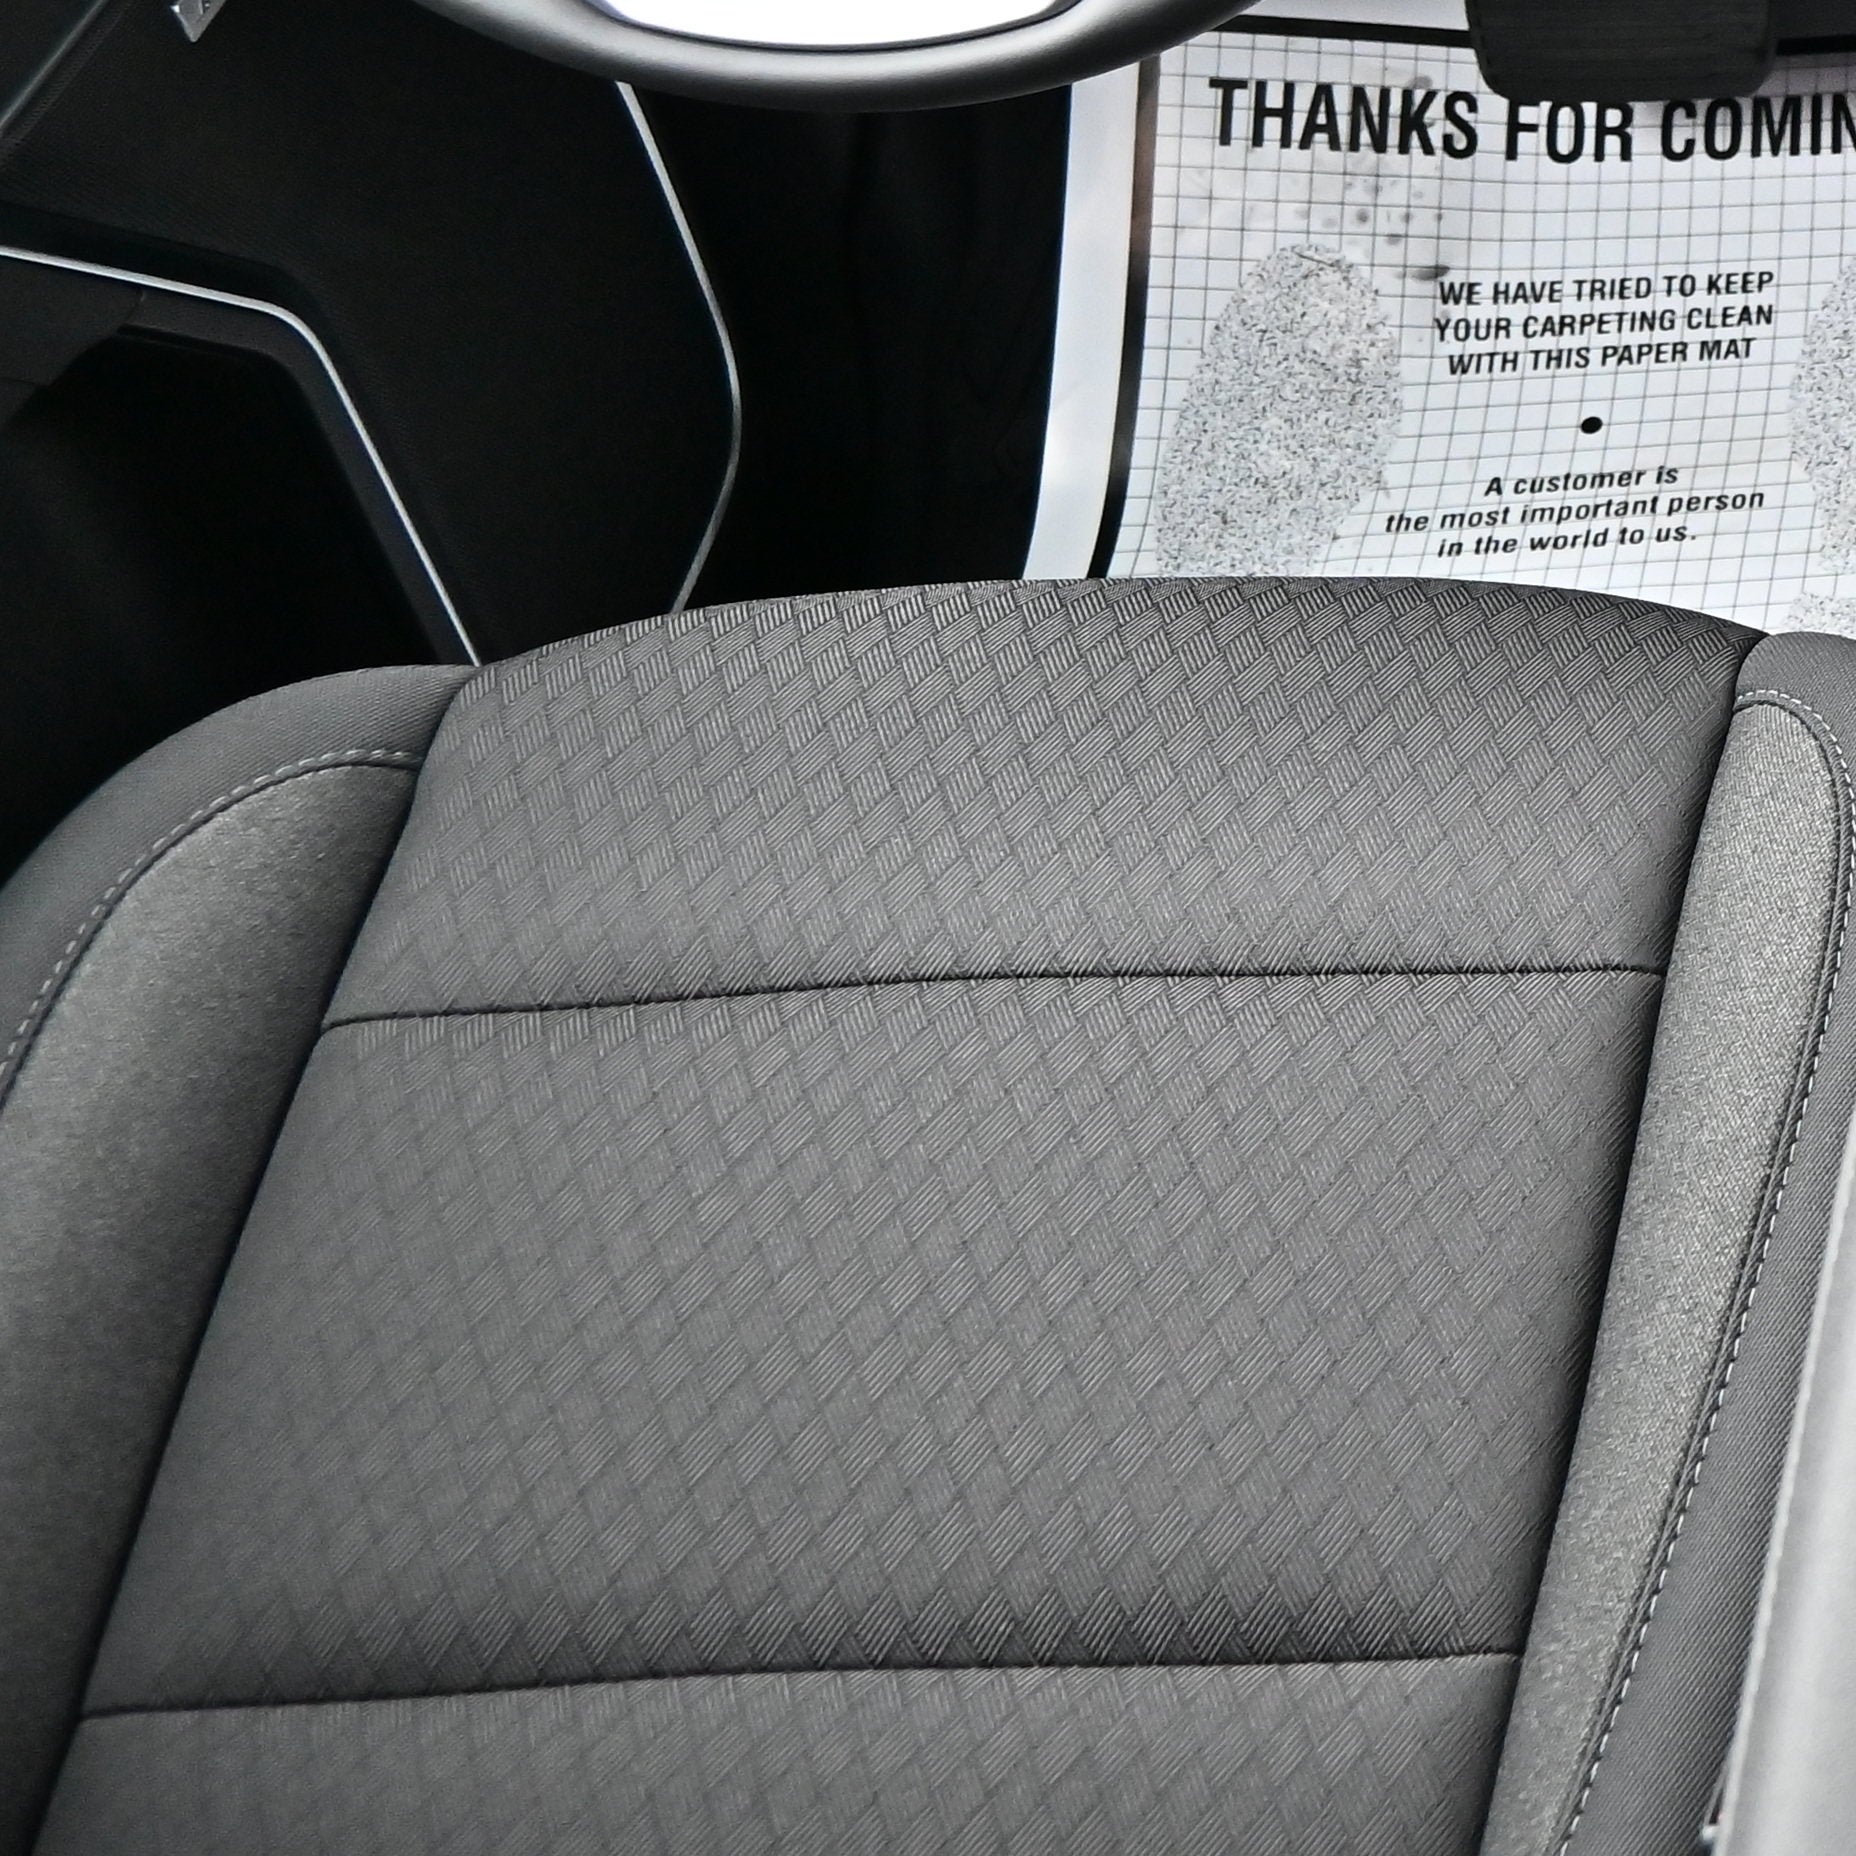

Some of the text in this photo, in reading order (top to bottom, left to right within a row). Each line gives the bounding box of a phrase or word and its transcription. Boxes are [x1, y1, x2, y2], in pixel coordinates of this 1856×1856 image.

[1208, 75, 1479, 161] THANKS
[1506, 100, 1634, 163] FOR
[1438, 270, 1775, 307] WE HAVE TRIED TO KEEP
[1432, 303, 1775, 344] YOUR CARPETING CLEAN
[1448, 336, 1758, 376] WITH THIS PAPER MAT
[1483, 464, 1680, 497] A customer is
[1384, 491, 1766, 534] the most important person
[1436, 524, 1699, 559] in the world to us.
